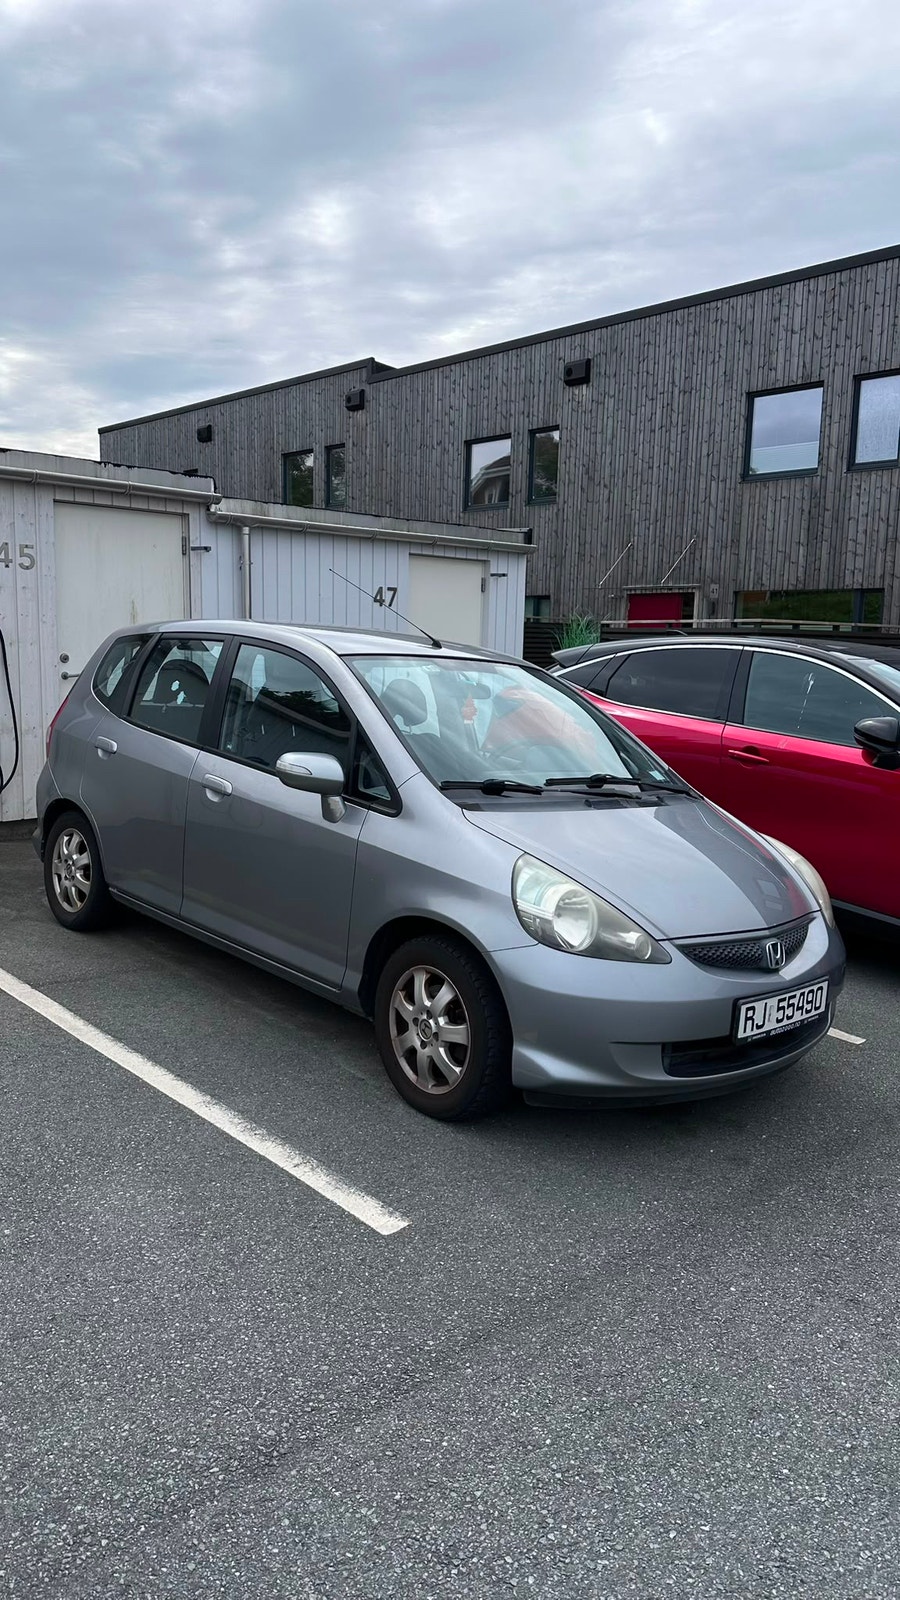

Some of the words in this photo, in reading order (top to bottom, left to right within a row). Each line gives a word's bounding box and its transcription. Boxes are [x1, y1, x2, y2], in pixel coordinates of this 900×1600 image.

[0, 542, 35, 570] 45
[374, 587, 397, 607] 47
[743, 1002, 768, 1033] RJ
[776, 986, 823, 1024] 55490
